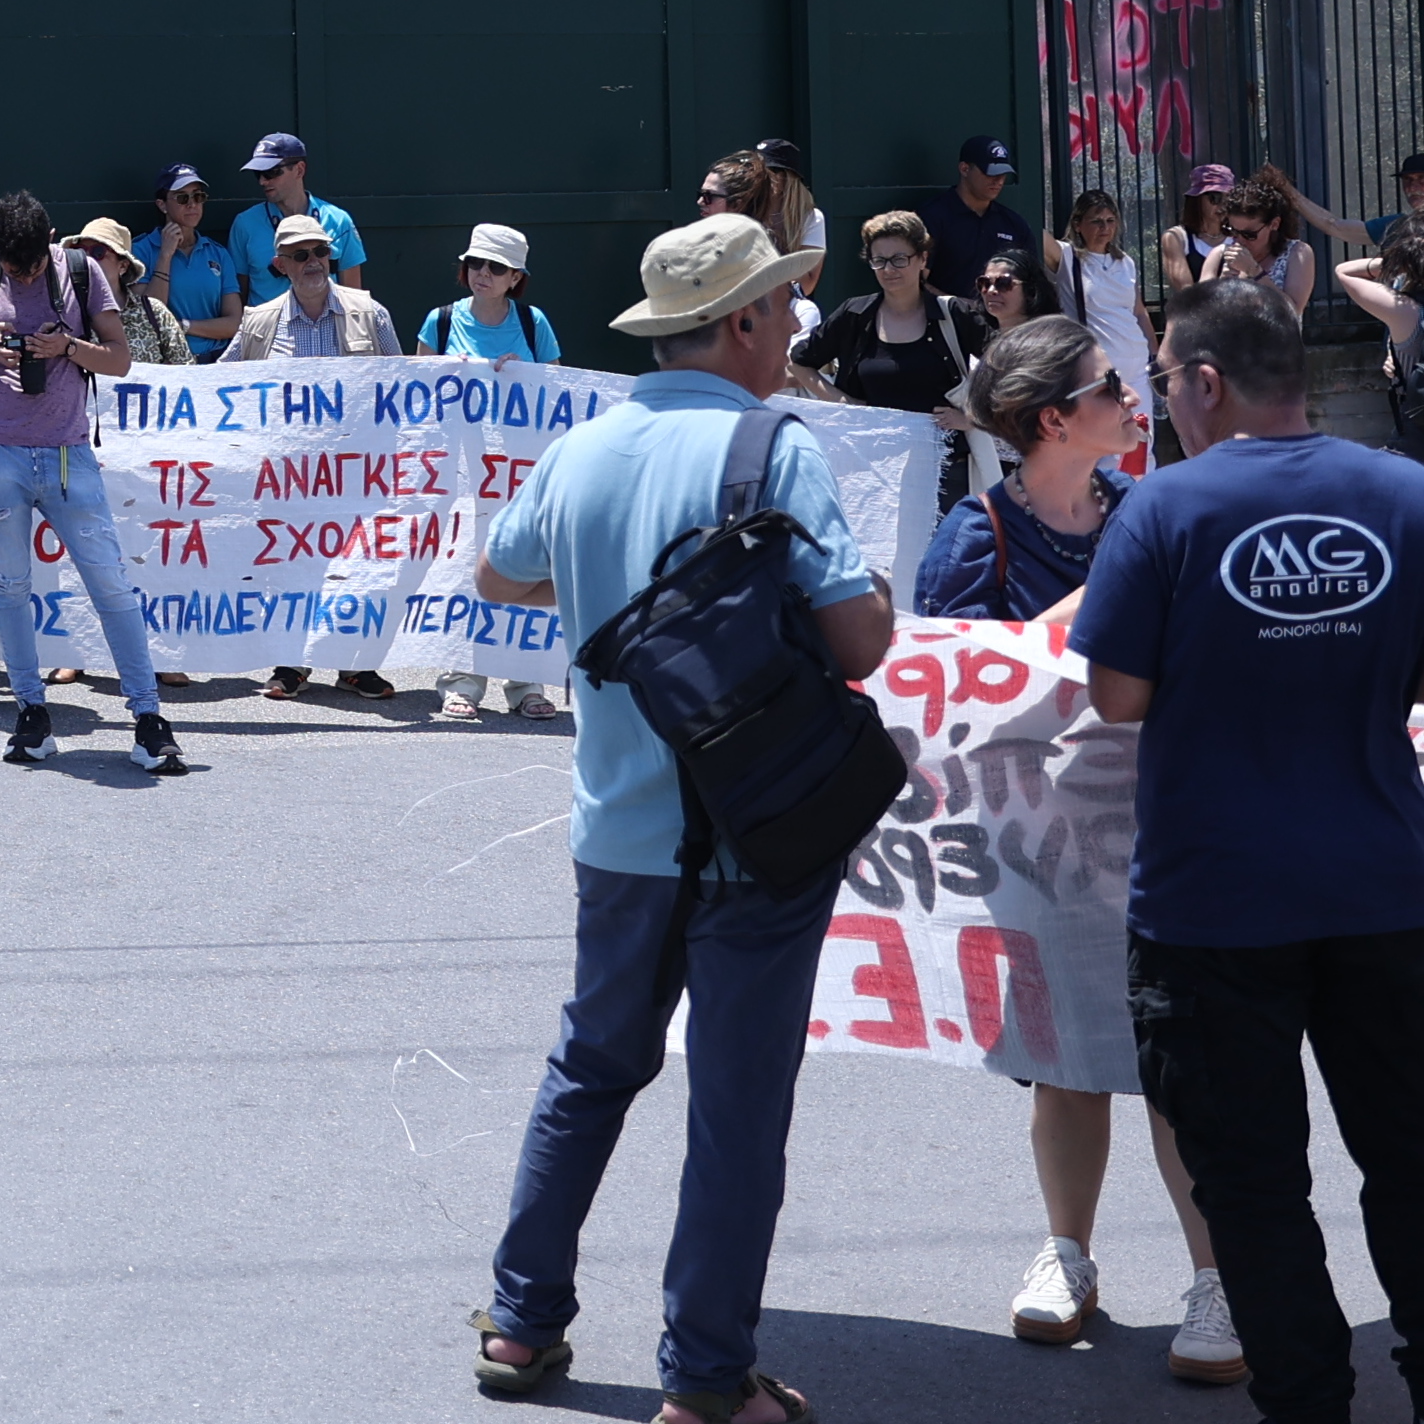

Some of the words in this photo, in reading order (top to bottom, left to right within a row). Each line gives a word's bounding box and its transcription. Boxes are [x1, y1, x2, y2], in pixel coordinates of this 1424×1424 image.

[114, 382, 196, 431] ΠΙΑ
[216, 379, 344, 431] ΣΤΗΝ
[150, 460, 215, 507] ΤΙΣ
[253, 451, 450, 500] ΑΝΑΓΚΕΣ
[150, 518, 208, 568] ΤΑ
[253, 511, 460, 566] ΣΧΟΛΕΙΑ!
[1250, 529, 1365, 577] MG
[132, 585, 385, 636] ΚΠΑΙΔΕΥΤΙΚΩΝ
[1250, 575, 1368, 598] anodica
[1258, 622, 1330, 639] MONOPOLI
[1335, 622, 1362, 636] (BA)
